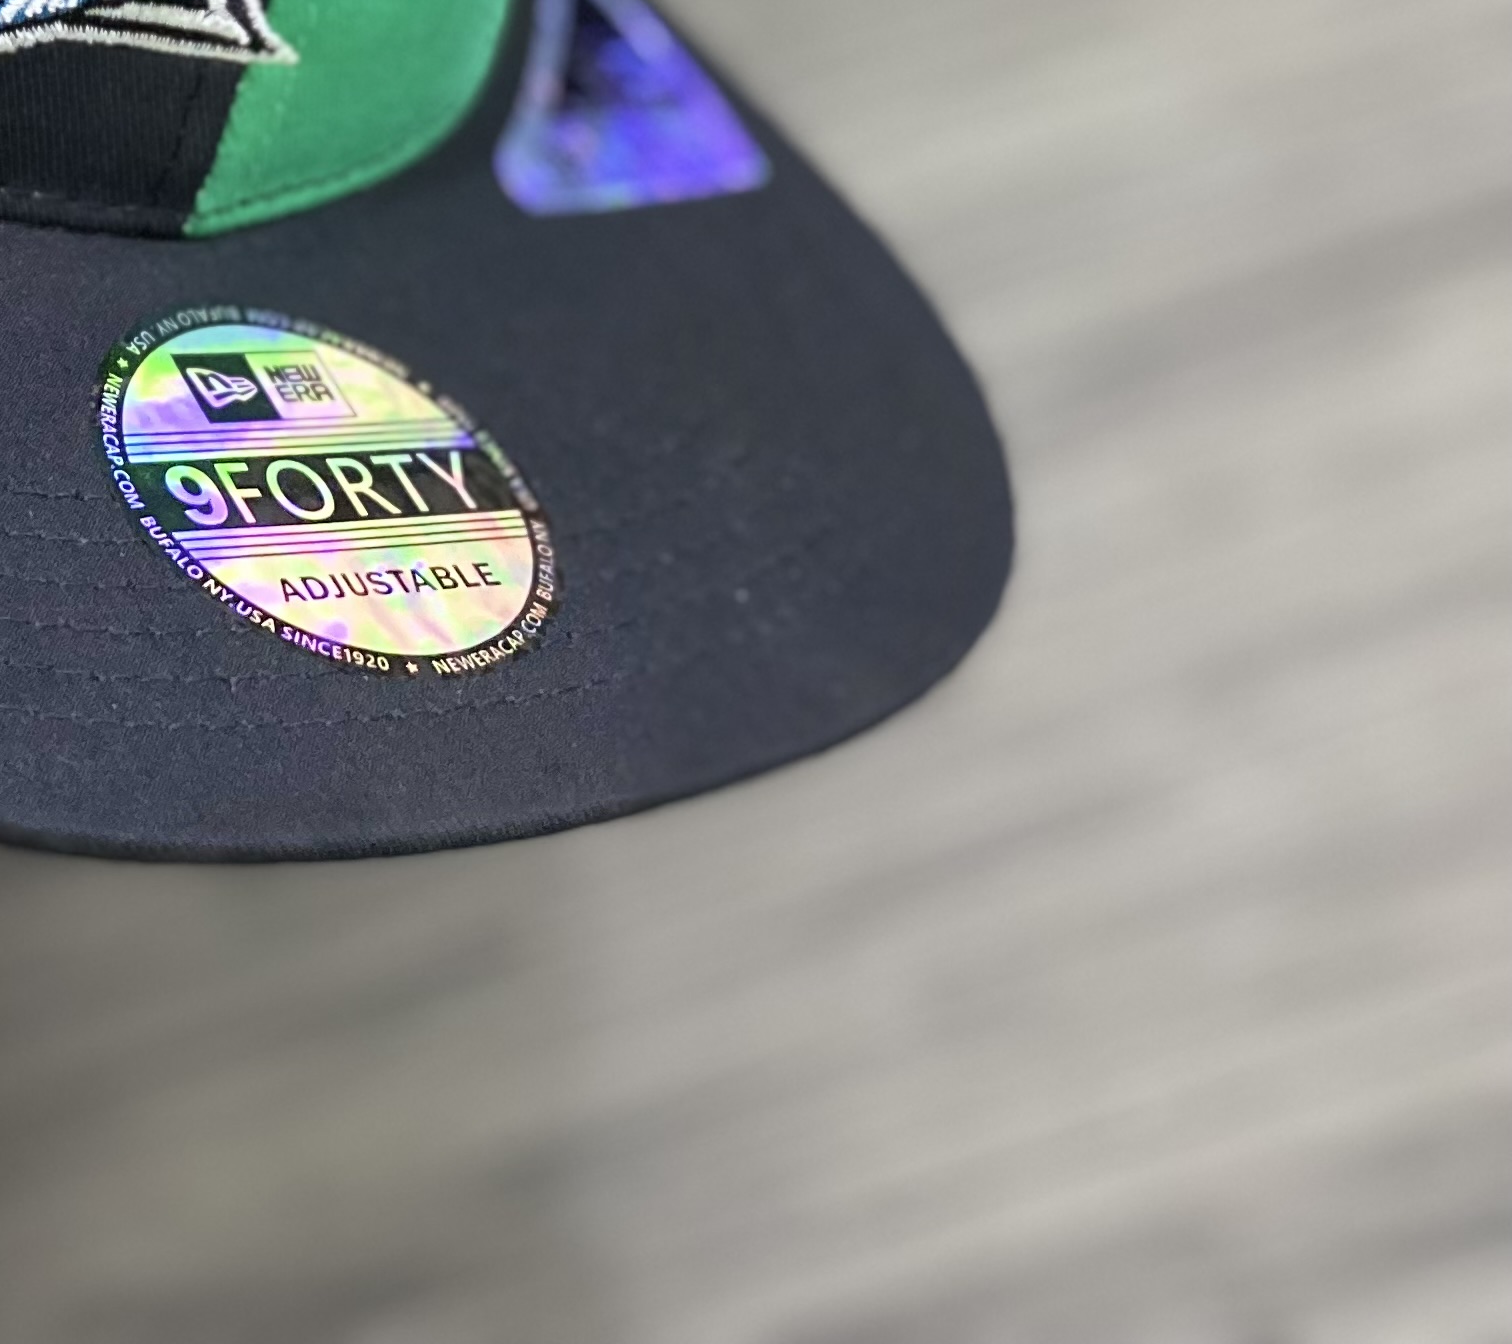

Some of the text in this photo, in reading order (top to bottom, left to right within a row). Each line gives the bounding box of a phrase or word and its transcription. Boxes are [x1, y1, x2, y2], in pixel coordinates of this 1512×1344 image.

[126, 330, 155, 356] USA
[263, 364, 322, 384] NEW
[275, 383, 336, 403] ERA
[99, 372, 146, 511] NEWERACAP.COM
[140, 515, 205, 580] BUFALO
[164, 450, 477, 526] 9FORTY
[280, 562, 502, 602] ADJUSTABLE
[535, 544, 555, 602] BUFALO
